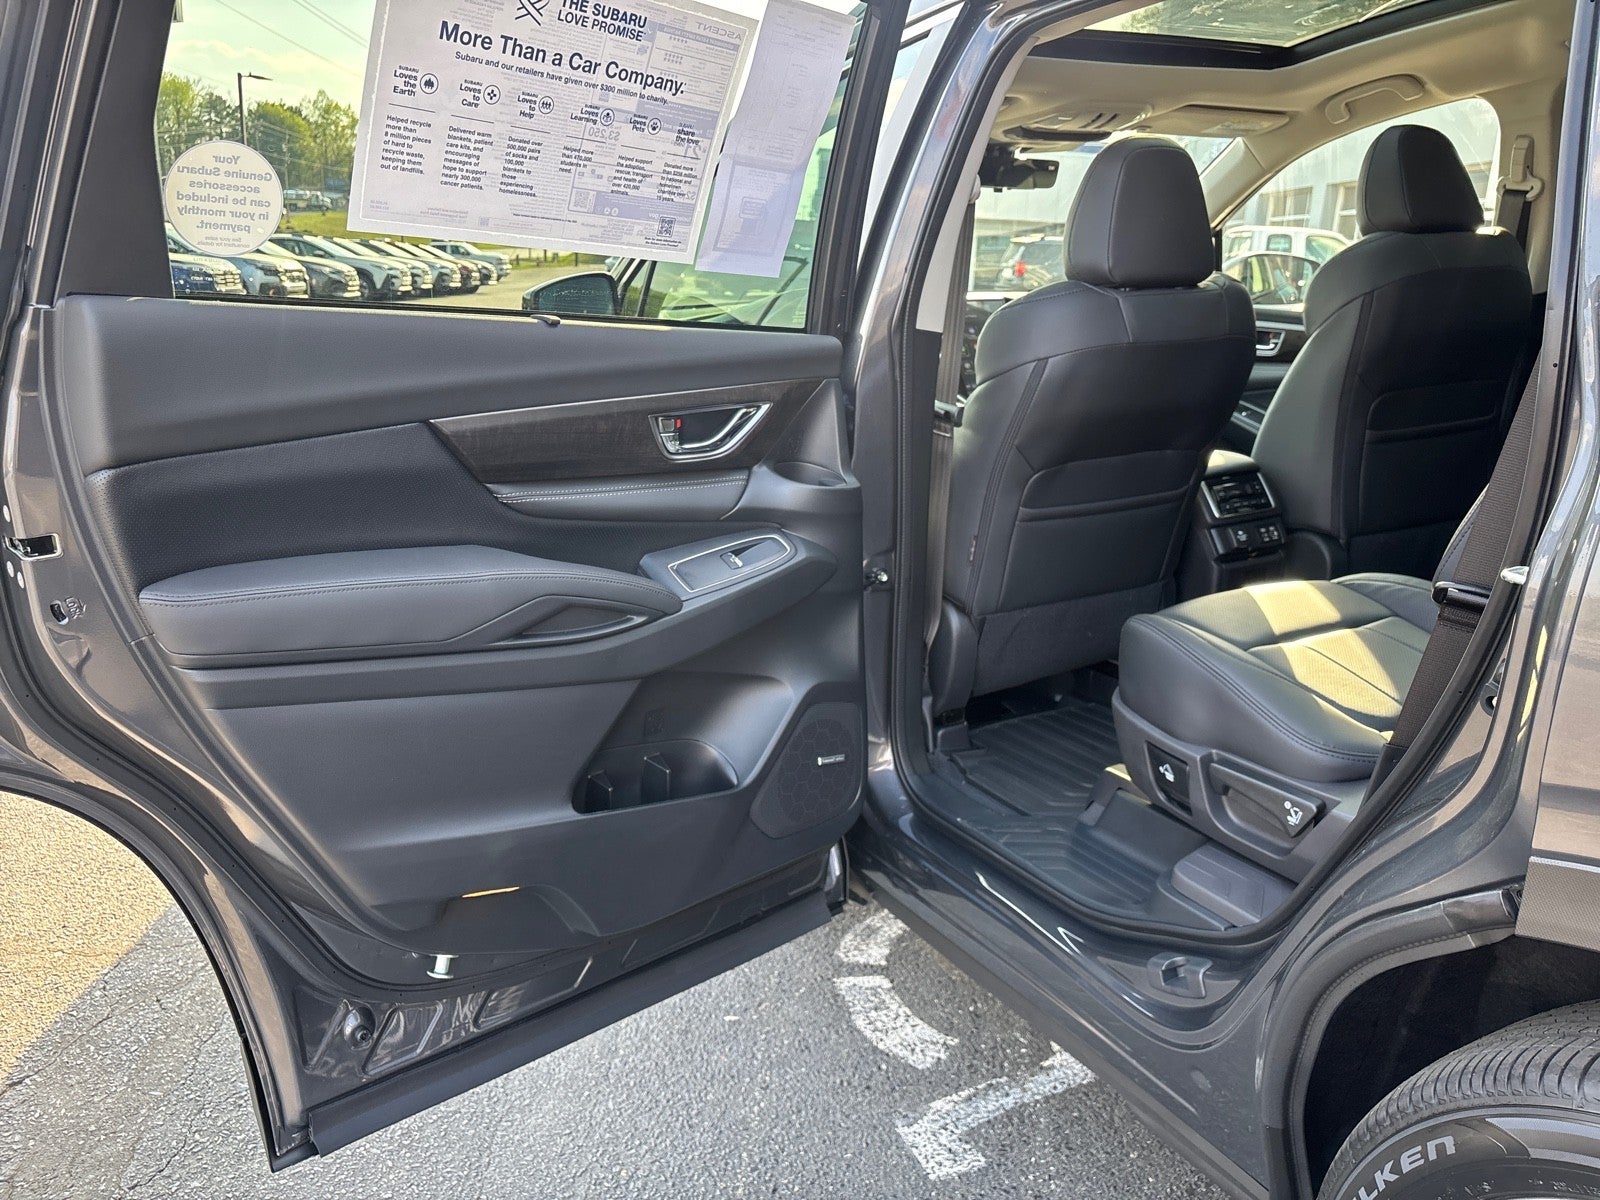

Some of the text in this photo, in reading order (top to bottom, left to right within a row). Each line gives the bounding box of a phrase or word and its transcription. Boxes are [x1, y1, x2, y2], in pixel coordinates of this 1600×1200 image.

[562, 0, 589, 13] THE
[592, 3, 647, 28] SUBARU
[558, 10, 589, 27] LOVE
[591, 19, 644, 41] PROMISE
[439, 20, 492, 50] More
[500, 35, 546, 63] Than
[551, 52, 563, 67] a
[569, 52, 601, 74] Car
[606, 61, 684, 96] Company.
[398, 65, 419, 73] SUBARU
[393, 70, 418, 82] Loves
[455, 51, 483, 65] Subaru
[485, 57, 499, 68] and
[501, 62, 513, 71] our
[515, 65, 544, 78] retailers
[546, 70, 562, 82] have
[564, 76, 582, 87] given
[584, 82, 599, 90] over
[600, 83, 615, 93] $300
[616, 88, 638, 97] million
[647, 94, 668, 106] charity.
[404, 80, 416, 89] the
[459, 84, 481, 94] Loves
[393, 86, 416, 97] Earth
[461, 98, 478, 109] Care
[518, 95, 537, 105] Loves
[519, 110, 534, 119] Help
[580, 108, 599, 117] Loves
[387, 115, 408, 124] Helped
[570, 113, 598, 125] Learning
[629, 118, 646, 126] Loves
[449, 126, 475, 135] Delivered
[677, 128, 695, 137] share
[447, 134, 473, 143] blankets,
[508, 136, 530, 145] Donated
[382, 148, 404, 156] recycle
[563, 146, 580, 154] Helped
[445, 150, 480, 160] encouraging
[381, 155, 405, 165] keeping
[444, 158, 472, 167] messages
[400, 166, 424, 175] landfills.
[502, 166, 525, 174] blankets
[500, 181, 533, 190] experiencing
[499, 188, 537, 197] homelessness.
[1351, 1135, 1456, 1200] LKEN
